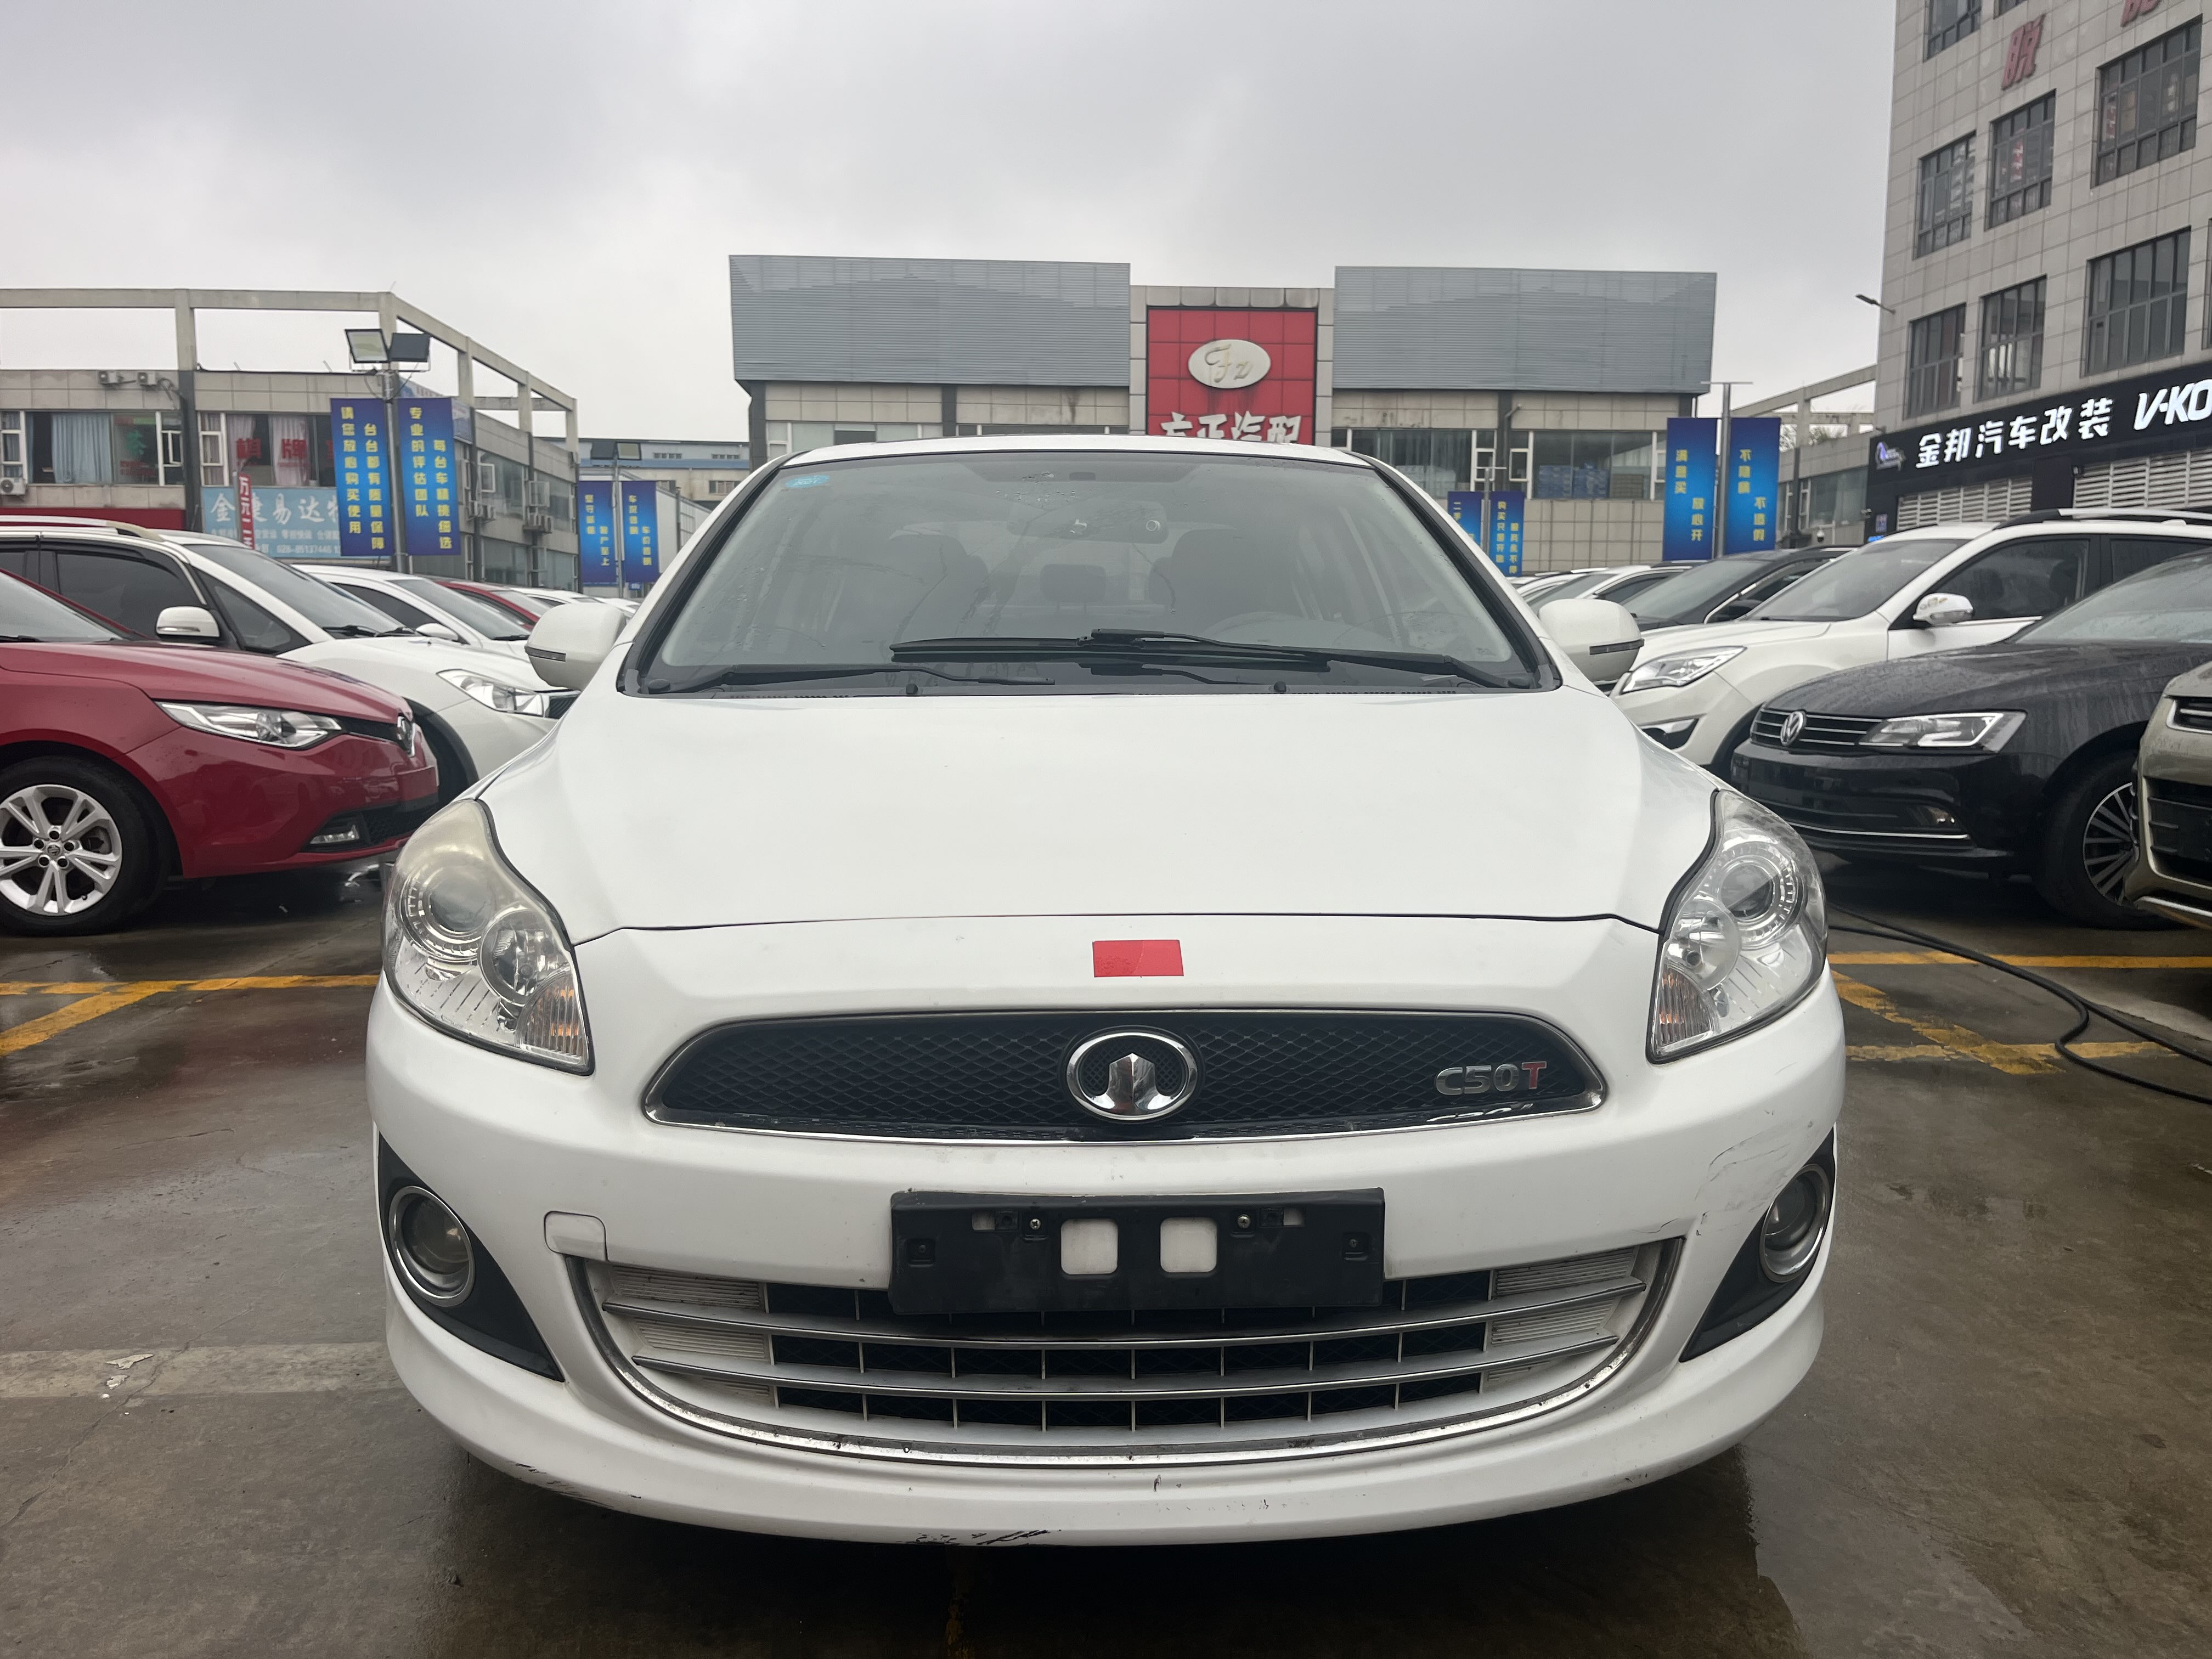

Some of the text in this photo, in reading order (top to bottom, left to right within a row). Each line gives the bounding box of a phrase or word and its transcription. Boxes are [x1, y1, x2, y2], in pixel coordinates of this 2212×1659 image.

[1915, 397, 2113, 468] 金邦汽车改装
[1435, 1060, 1547, 1096] C50T
